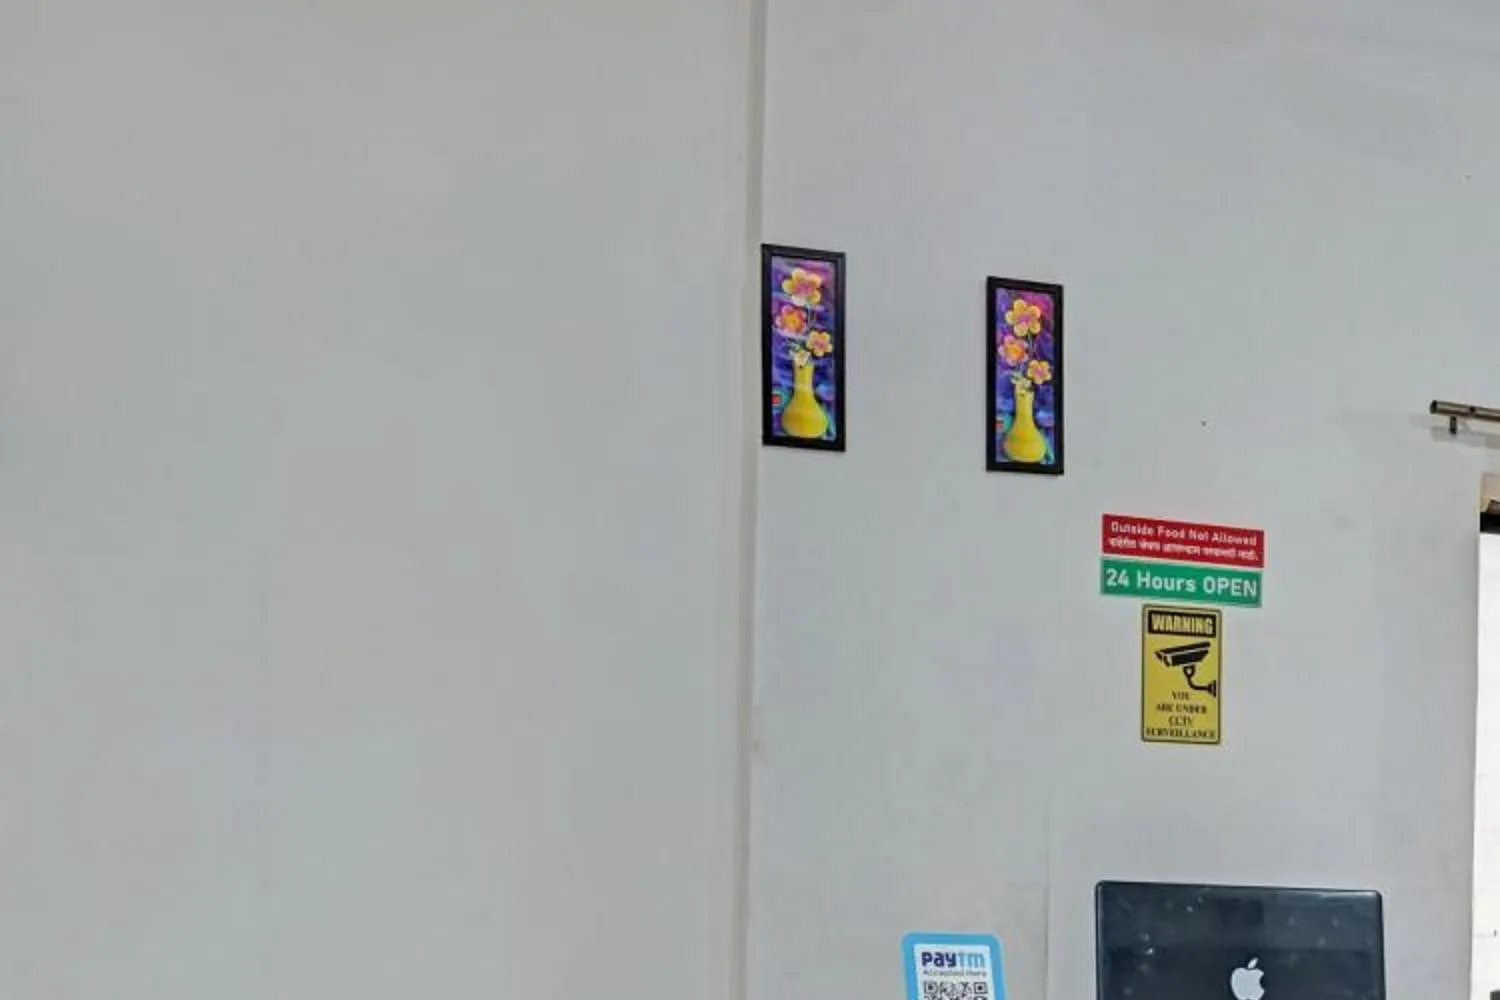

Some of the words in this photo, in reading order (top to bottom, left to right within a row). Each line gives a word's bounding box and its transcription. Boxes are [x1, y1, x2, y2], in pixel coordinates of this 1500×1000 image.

[1111, 521, 1154, 536] Outside
[1157, 525, 1185, 539] Food
[1188, 528, 1209, 541] Not
[1211, 531, 1257, 546] Allowed
[1105, 568, 1130, 587] 24
[1137, 569, 1197, 593] Hours
[1203, 575, 1257, 597] OPEN
[1151, 613, 1214, 634] WARNING
